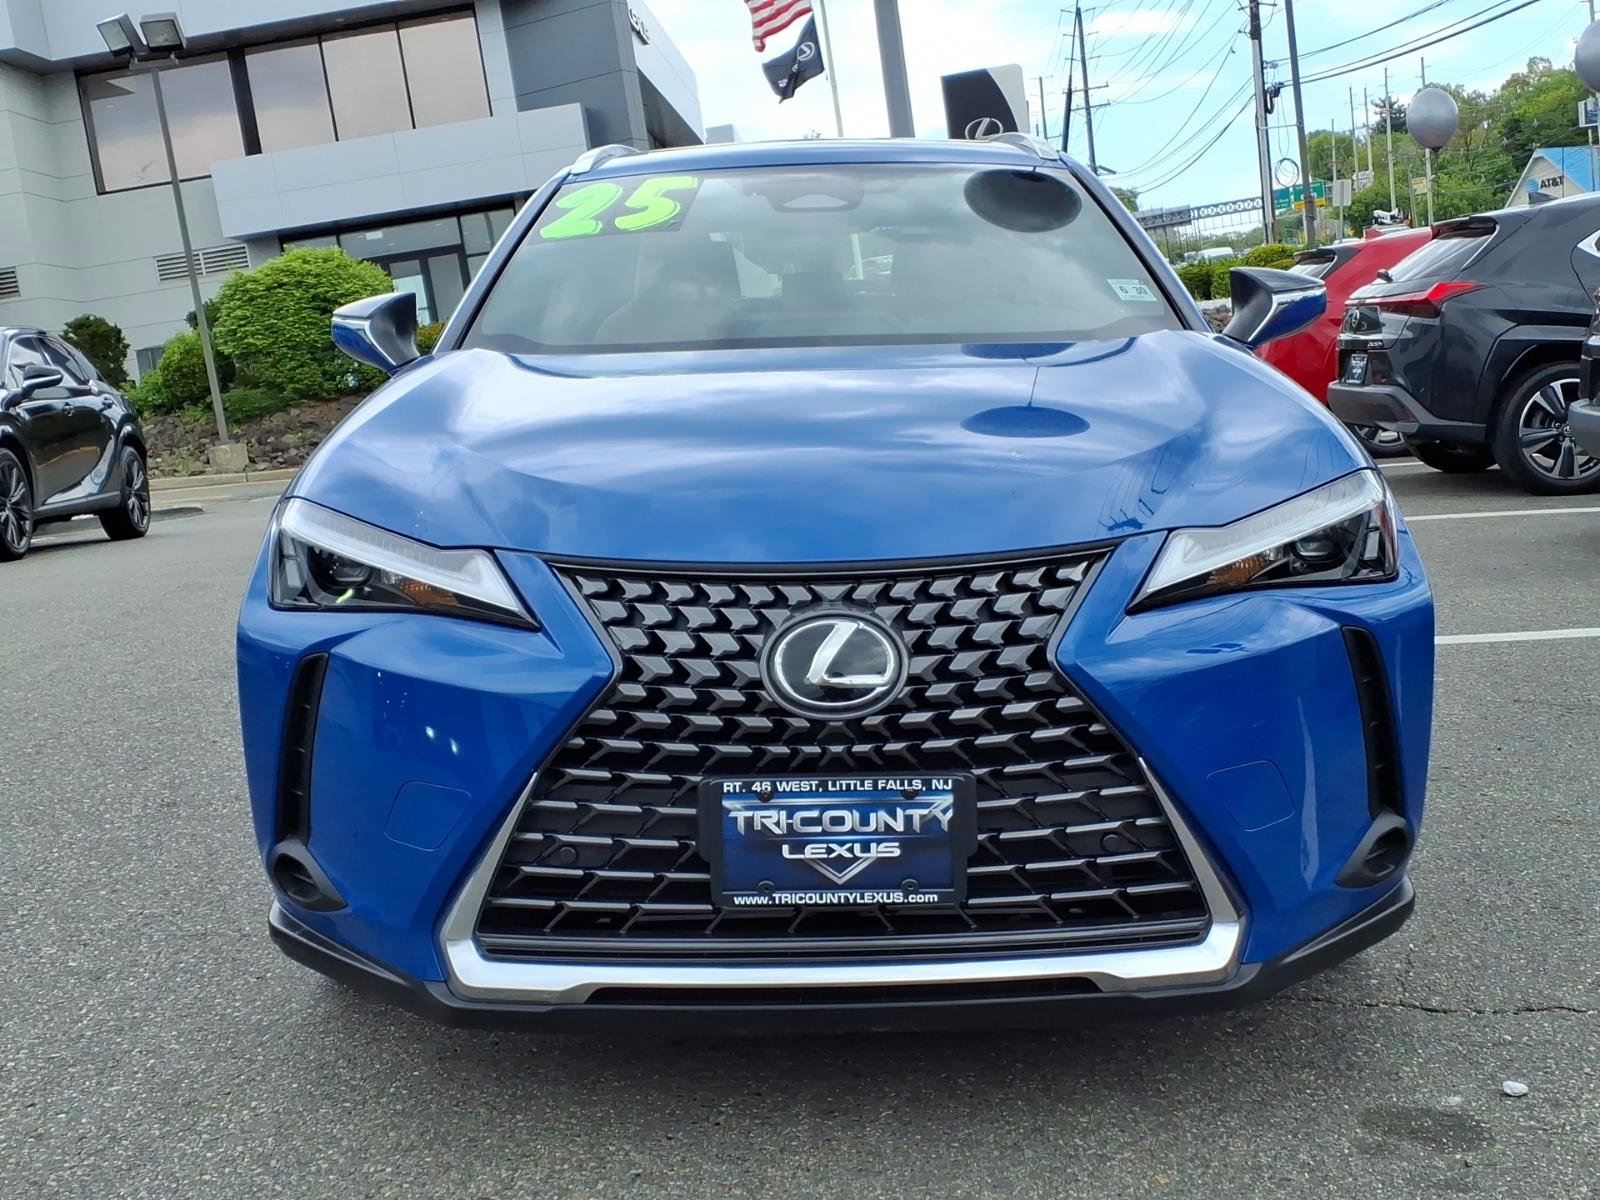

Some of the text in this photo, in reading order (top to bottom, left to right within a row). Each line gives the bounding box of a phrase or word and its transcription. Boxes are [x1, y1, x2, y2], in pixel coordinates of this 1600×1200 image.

[1540, 176, 1564, 190] AT&T
[539, 176, 698, 238] 25
[723, 779, 952, 793] RT. 46 WEST, LITTLE FALLS, NJ
[728, 807, 953, 835] TRI-COUNTY
[782, 842, 901, 859] LEXUS
[734, 892, 938, 905] www.TRICOUNTYLEXUS.com
